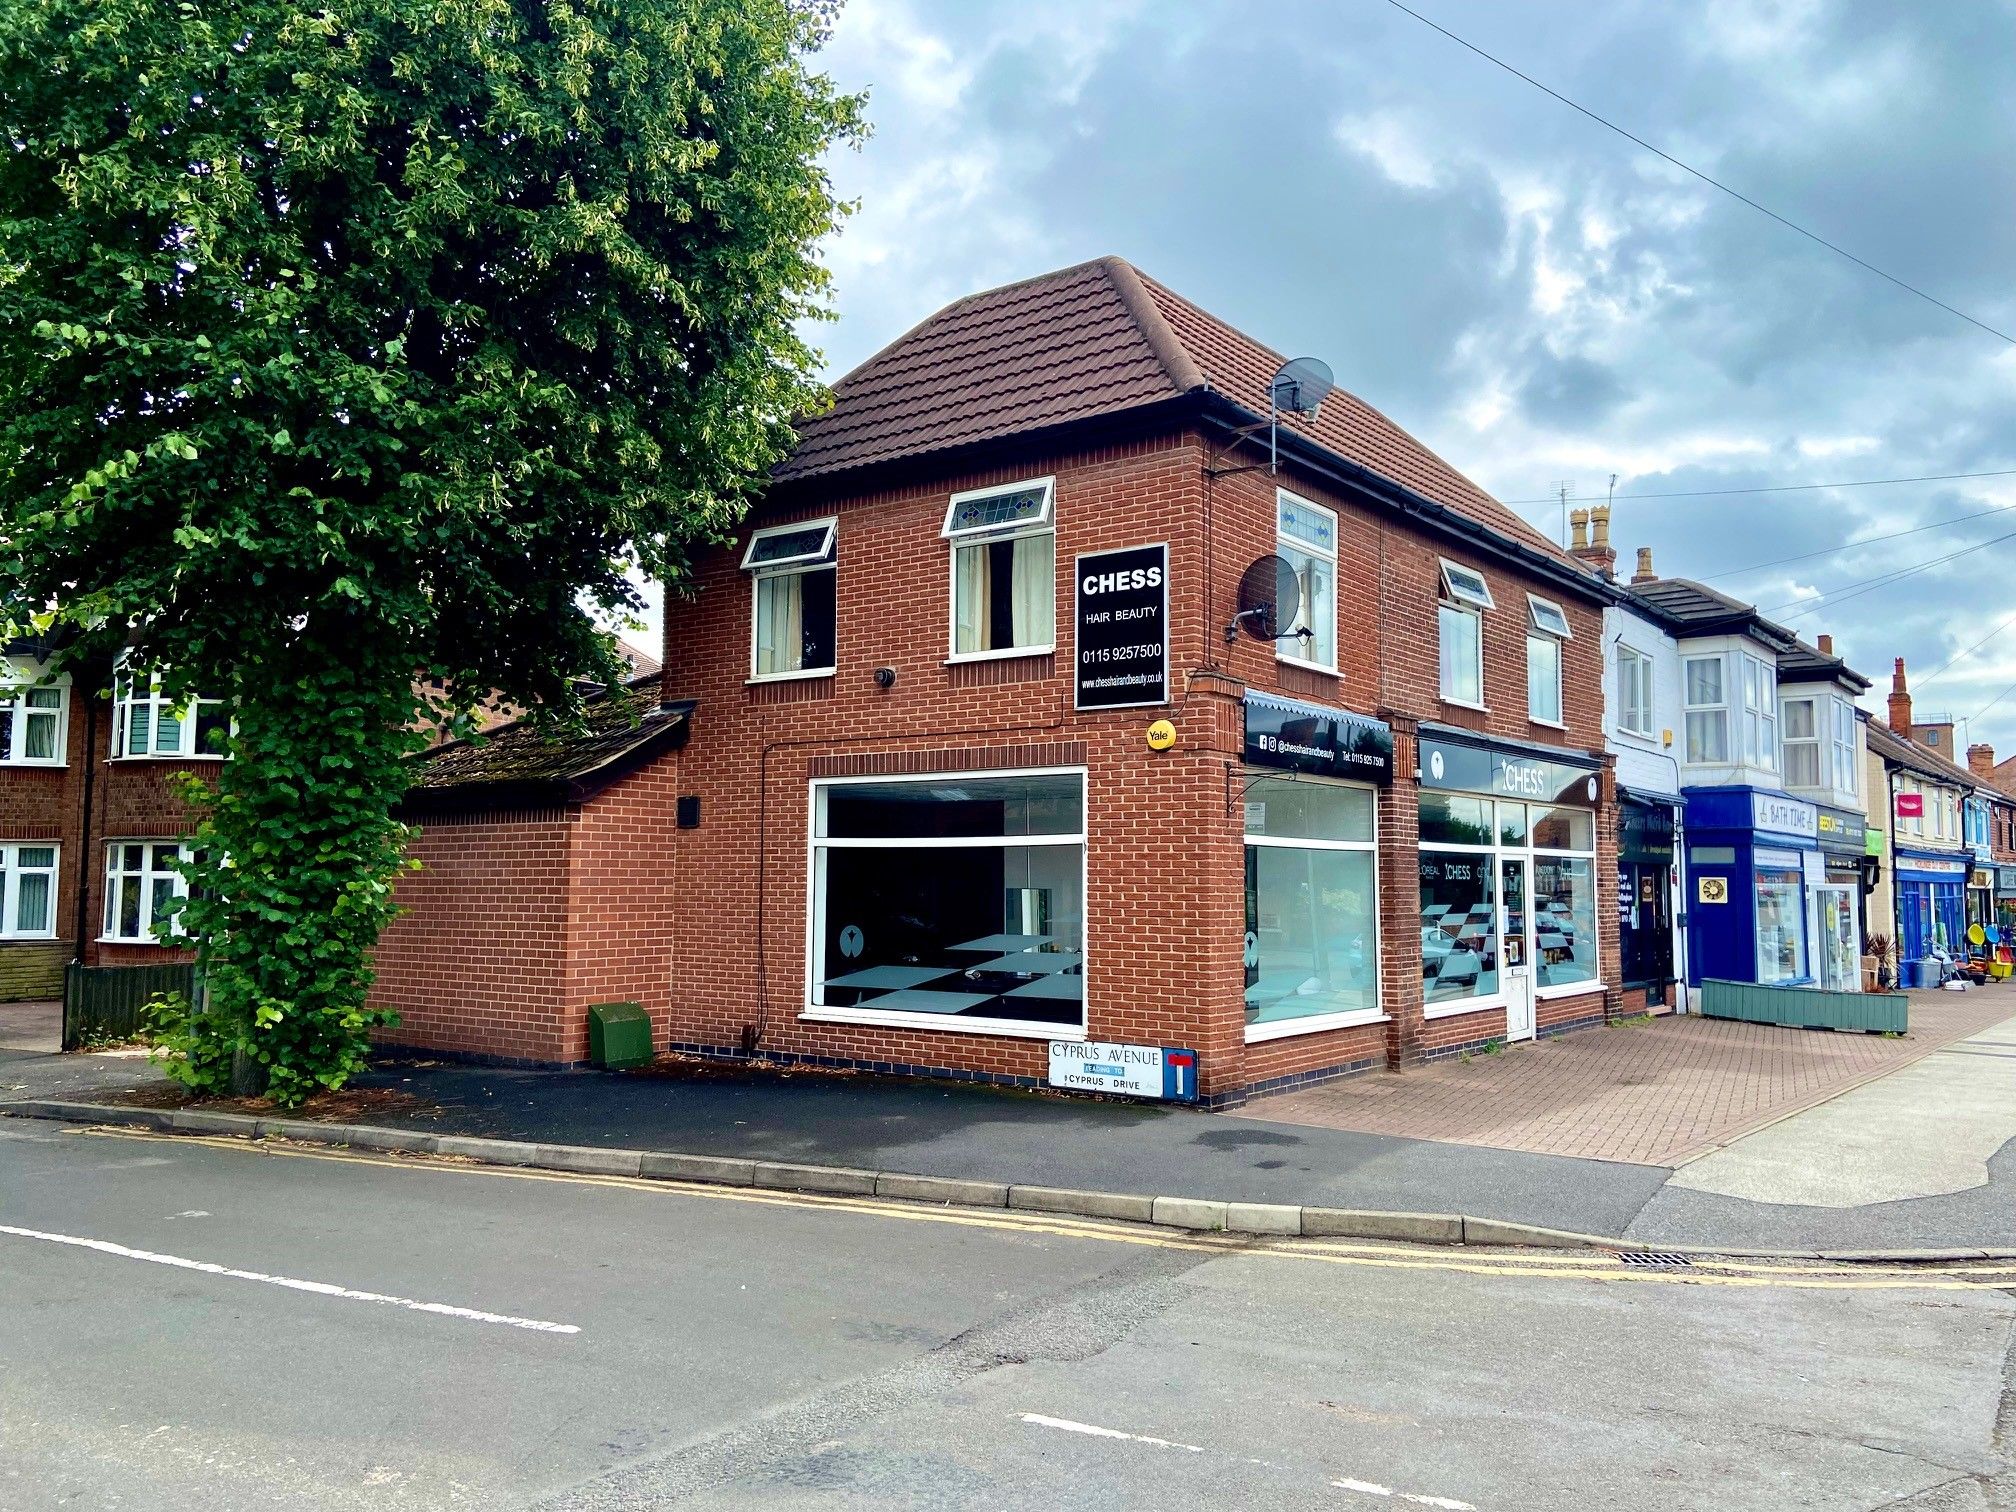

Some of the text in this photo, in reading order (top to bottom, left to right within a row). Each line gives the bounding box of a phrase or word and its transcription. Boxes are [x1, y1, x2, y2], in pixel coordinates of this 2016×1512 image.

[1082, 566, 1162, 596] CHESS
[1086, 606, 1158, 624] HAIR BEAUTY
[1082, 643, 1162, 664] 0115 9257500
[1081, 672, 1163, 689] www.chesshairandbeauty.co.uk
[1149, 730, 1168, 740] Yale
[1278, 740, 1335, 761] @chesshairandbeauty
[1351, 752, 1363, 764] 0115
[1363, 754, 1373, 765] 925
[1373, 755, 1385, 767] 7500
[1504, 764, 1544, 795] CHESS
[1770, 804, 1788, 826] BATH
[1789, 806, 1806, 828] TIME
[1447, 864, 1471, 880] CHESS
[1052, 1043, 1159, 1066] CYPRUS AVENUE
[1068, 1074, 1140, 1090] CYPRUS DRIVE
